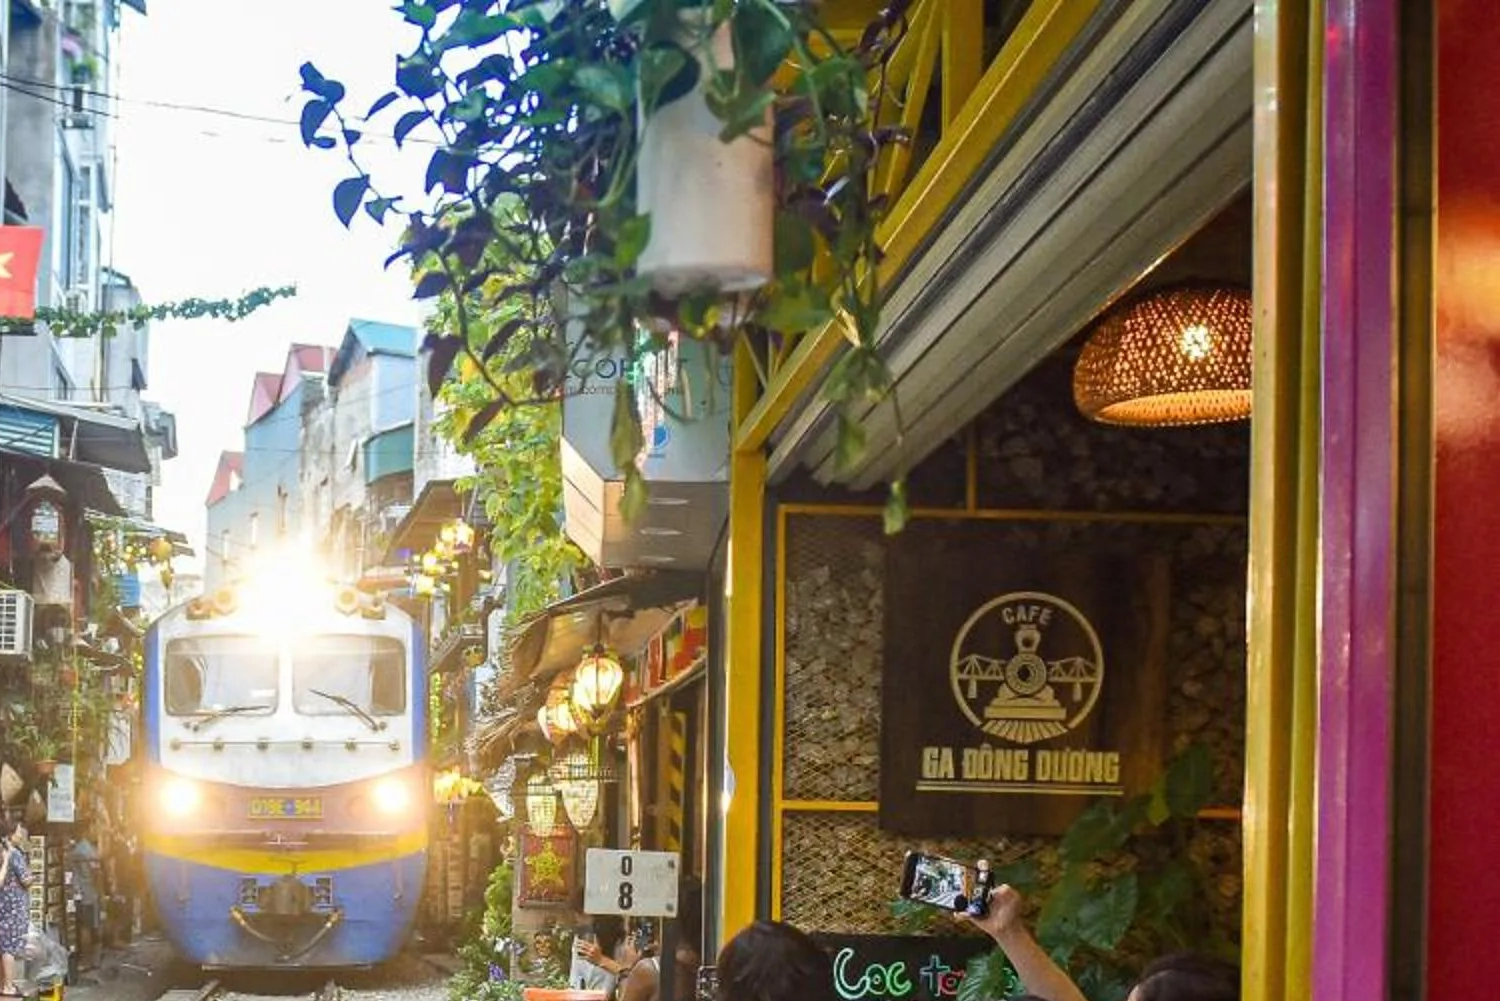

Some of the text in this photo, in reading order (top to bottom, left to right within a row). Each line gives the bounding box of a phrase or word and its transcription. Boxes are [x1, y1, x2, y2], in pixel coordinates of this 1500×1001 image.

[1002, 605, 1052, 625] CAFE
[923, 747, 955, 779] GA
[962, 743, 1029, 780] ĐÔNG
